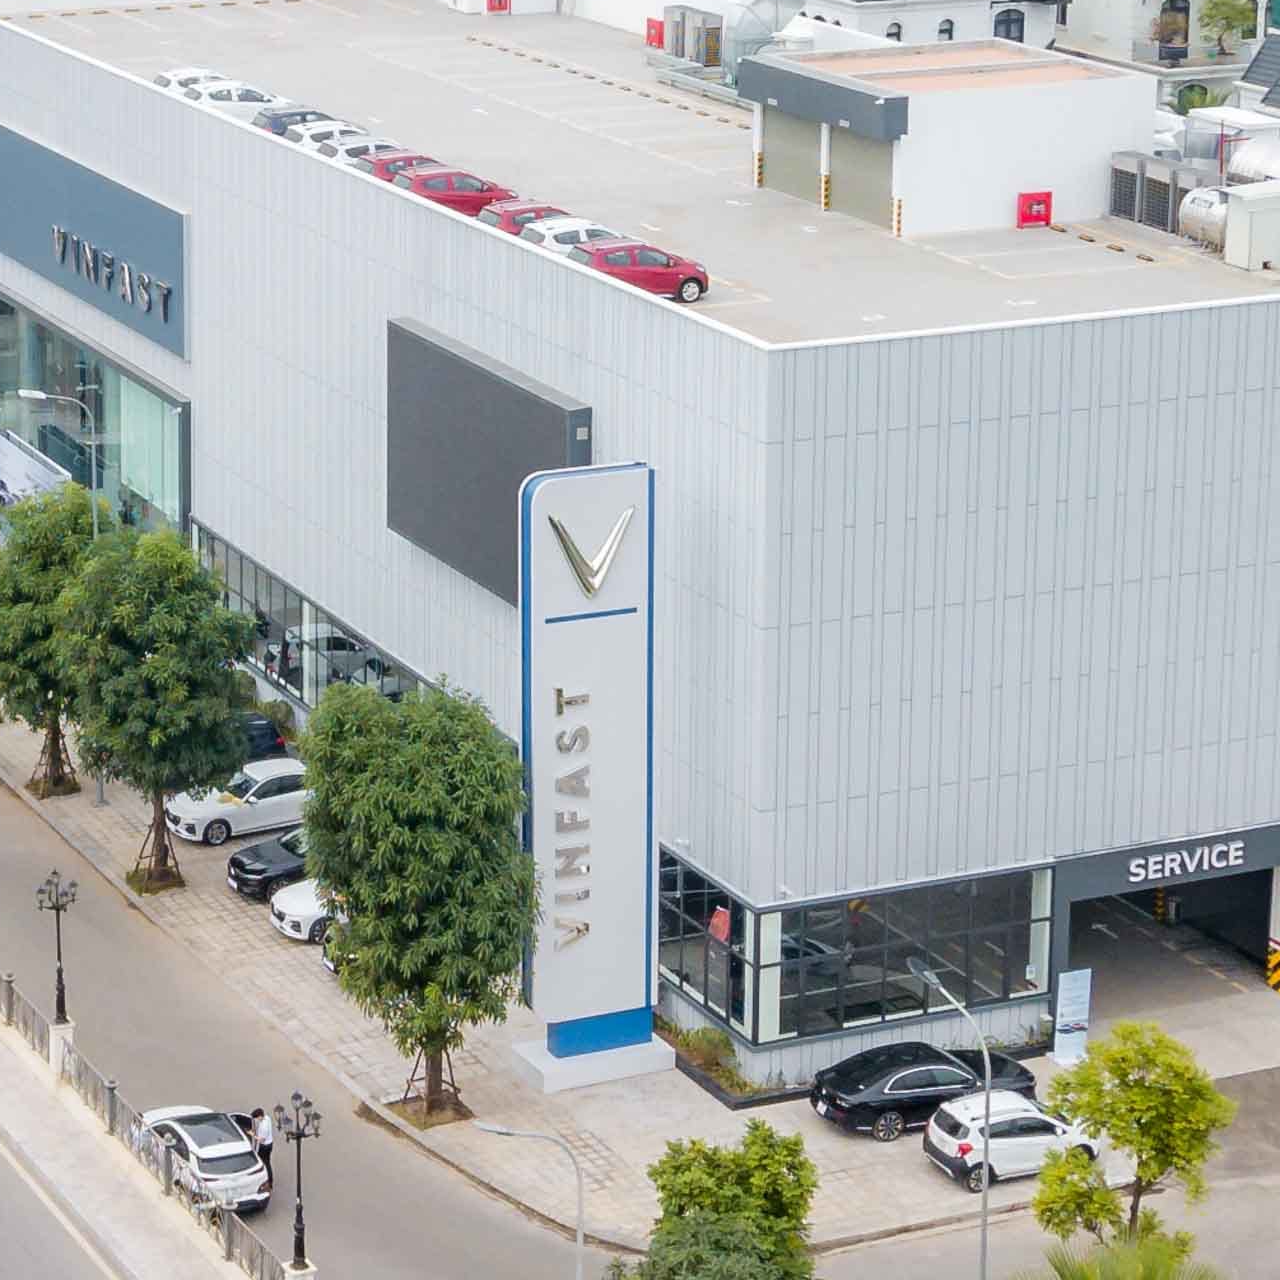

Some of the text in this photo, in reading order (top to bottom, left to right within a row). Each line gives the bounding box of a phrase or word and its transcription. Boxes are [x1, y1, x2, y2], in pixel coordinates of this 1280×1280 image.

[51, 223, 173, 324] VINFAST
[553, 687, 591, 953] VINFAST
[1128, 840, 1246, 883] SERVICE
